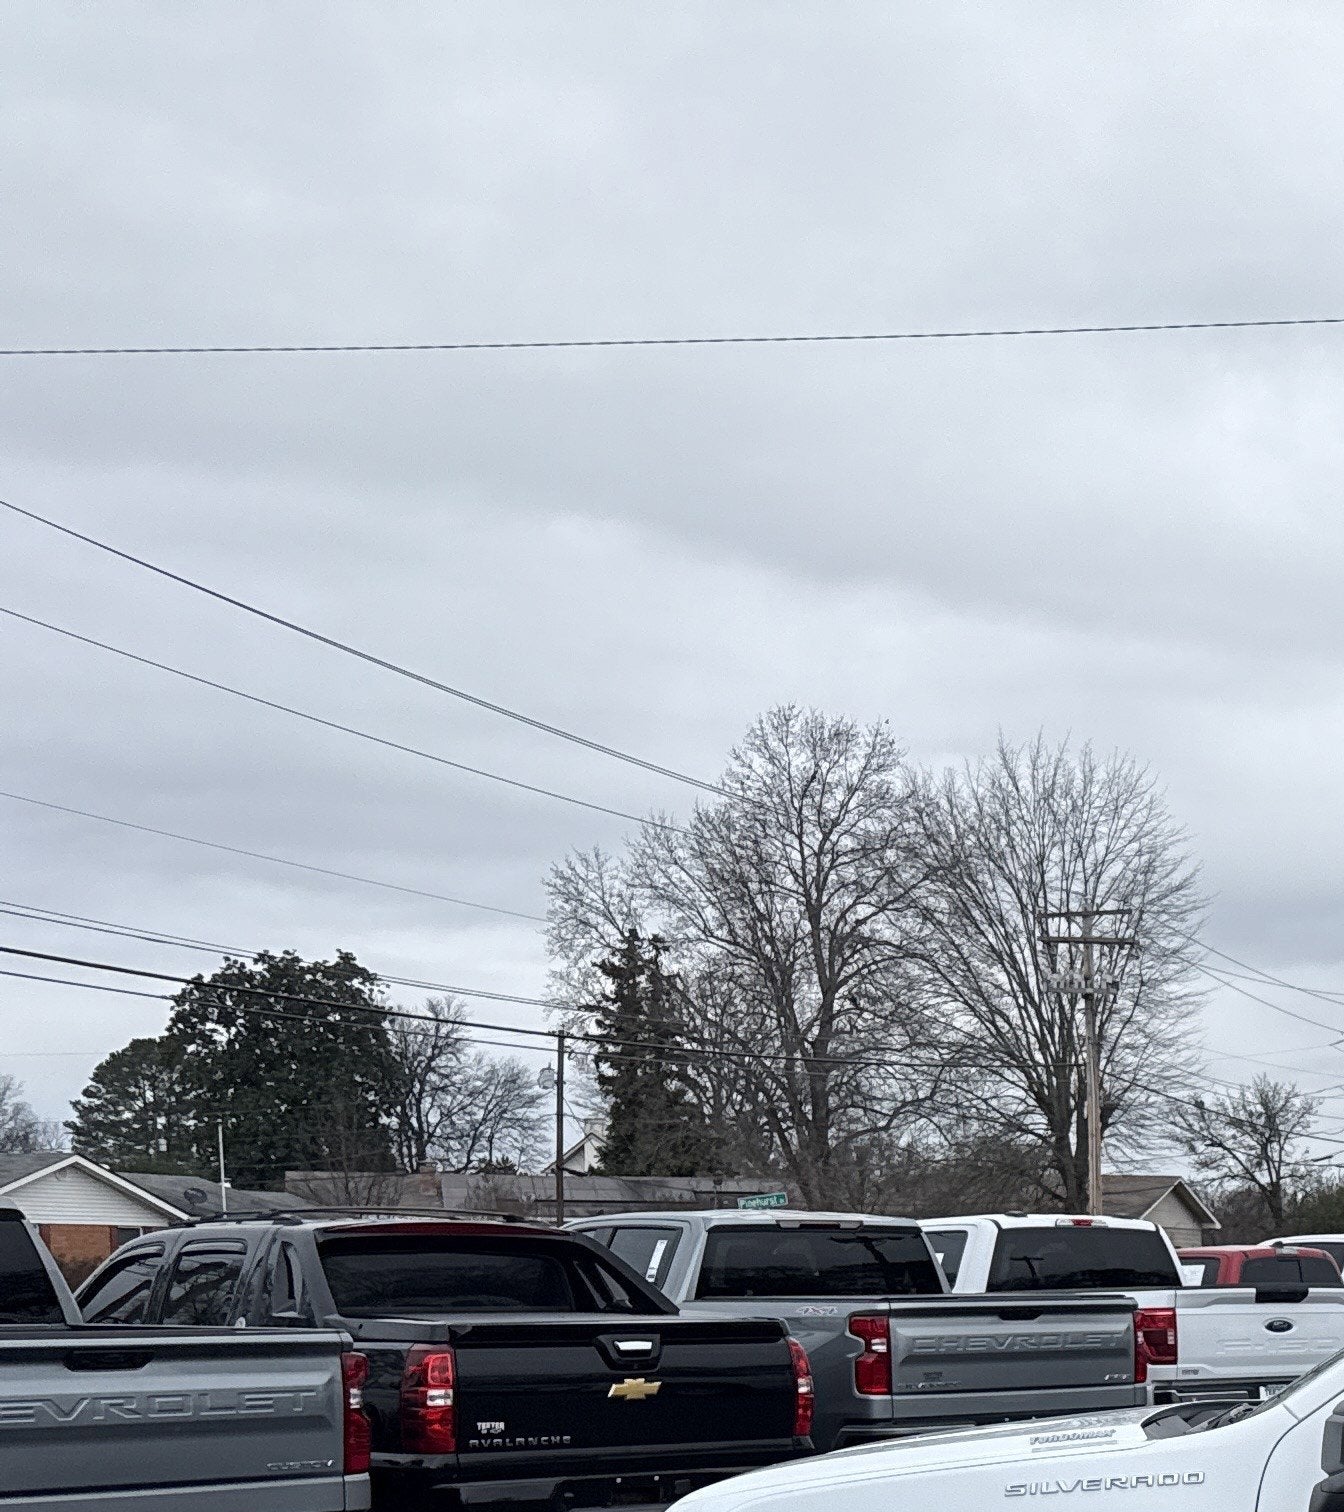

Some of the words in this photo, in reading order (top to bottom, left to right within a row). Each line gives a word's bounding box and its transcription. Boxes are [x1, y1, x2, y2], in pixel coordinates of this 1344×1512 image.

[911, 1331, 1128, 1352] CHEVROLET
[468, 1435, 572, 1449] AVALANCHE
[1004, 1471, 1206, 1497] SILVERADO
